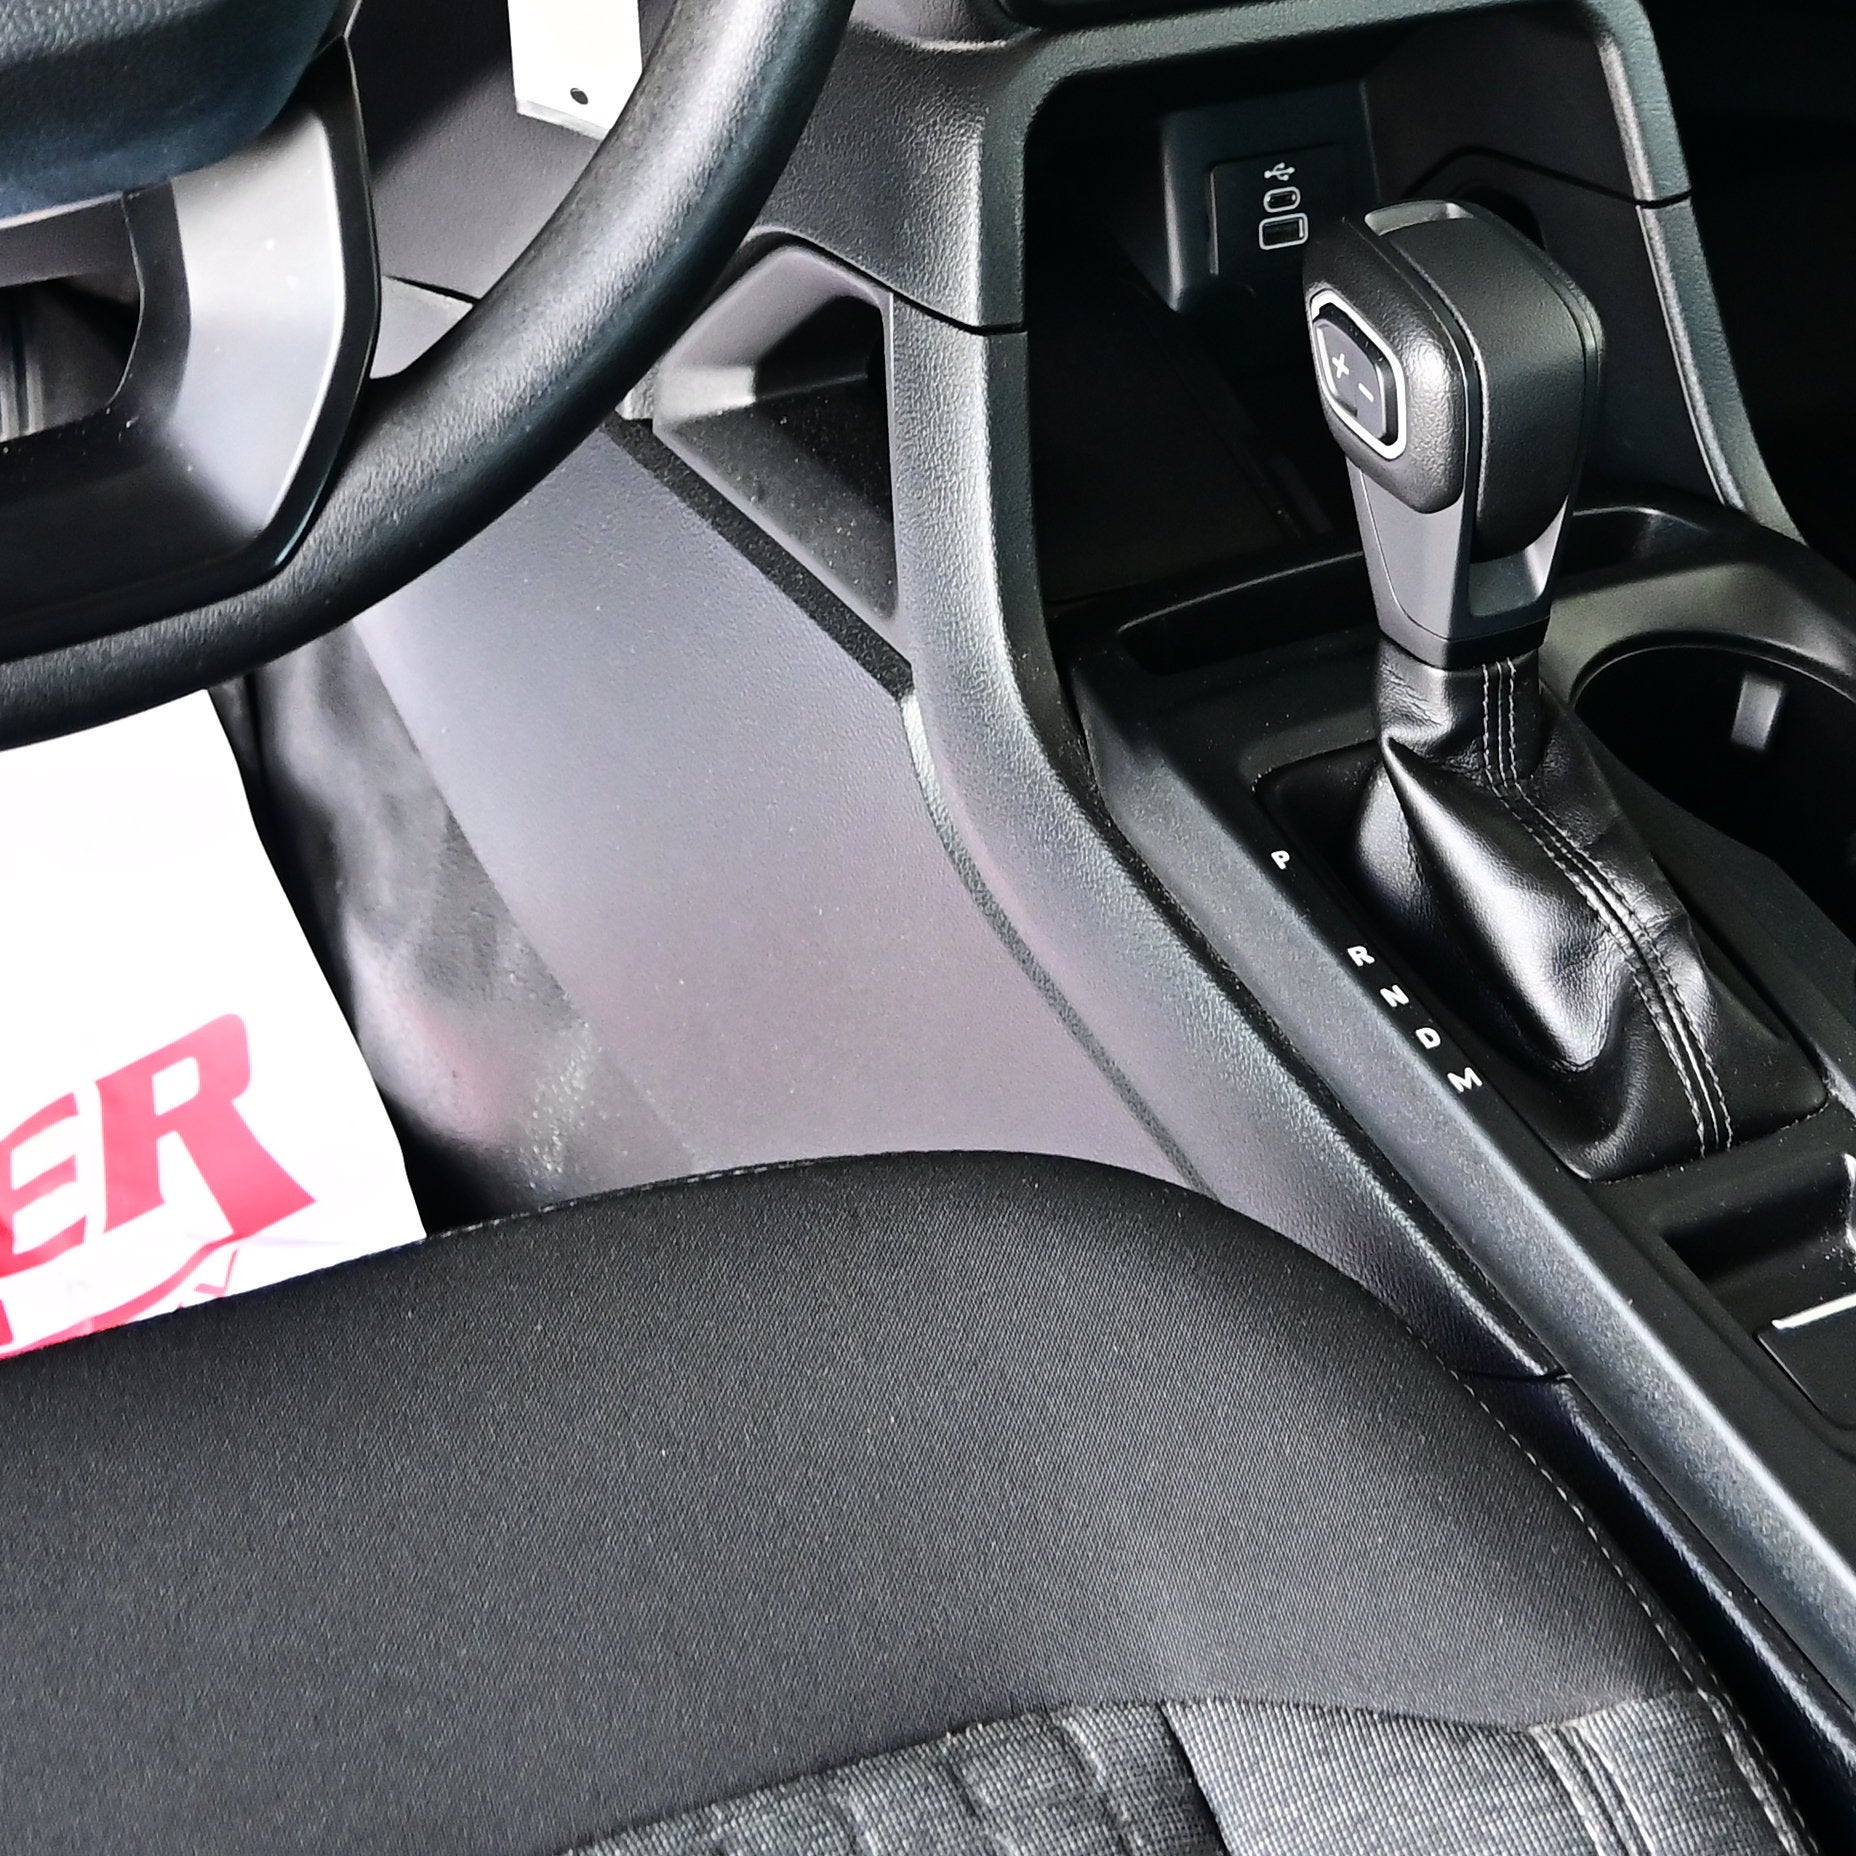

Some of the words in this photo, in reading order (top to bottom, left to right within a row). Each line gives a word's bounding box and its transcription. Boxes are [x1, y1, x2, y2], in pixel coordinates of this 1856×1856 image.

[1270, 850, 1290, 870] P
[1347, 945, 1375, 967] R
[1379, 985, 1410, 1008] N
[1415, 1028, 1442, 1051] D
[1447, 1066, 1483, 1094] M
